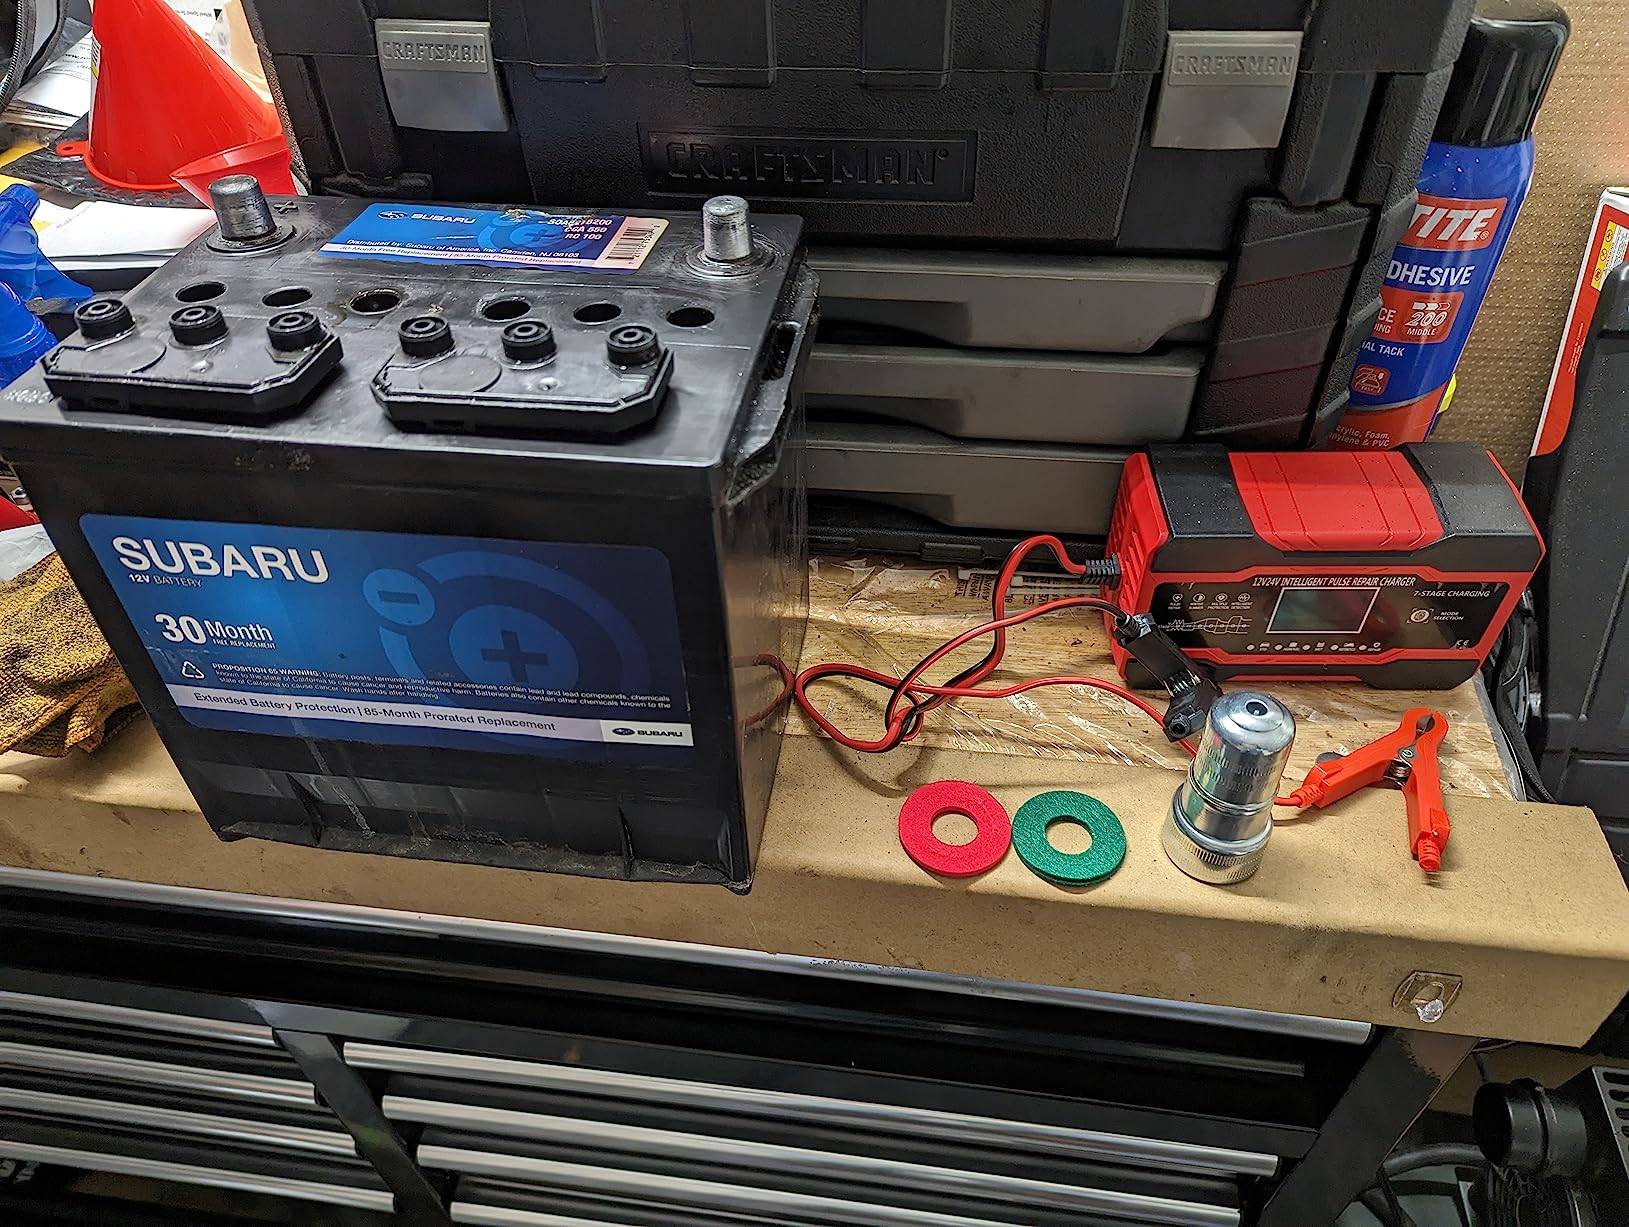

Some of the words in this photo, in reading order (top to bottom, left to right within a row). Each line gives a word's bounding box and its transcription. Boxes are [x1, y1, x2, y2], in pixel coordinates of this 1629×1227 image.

[382, 42, 486, 62] CRAFTSMAN
[1172, 55, 1293, 75] CRAFTSMAN
[667, 143, 934, 185] CRAFTSMAN
[411, 213, 476, 224] SUBARU
[397, 248, 447, 257] Replacement
[528, 256, 582, 264] Replacement
[447, 245, 481, 253] America,
[1386, 260, 1475, 286] DHESIVE
[1404, 311, 1448, 328] 200
[1374, 323, 1392, 334] ING
[1406, 328, 1437, 336] MIDDLE
[1378, 344, 1405, 357] TACK
[1371, 439, 1390, 447] PVC
[112, 536, 330, 584] SUBARU
[129, 573, 151, 584] 12V
[153, 576, 202, 588] BATTERY
[1252, 577, 1281, 587] 12V24V
[1280, 577, 1329, 587] INTELLIGENT
[1327, 577, 1353, 586] PULSE
[1351, 577, 1380, 586] REPAIR
[1379, 577, 1417, 587] CHARGER
[1413, 590, 1447, 598] 7-STAGE
[1447, 590, 1491, 598] CHARGING
[155, 614, 207, 645] 30
[204, 620, 273, 641] Month
[230, 640, 276, 650] REPLACEMENT
[211, 662, 268, 674] PROPOSITION
[279, 668, 321, 677] WARNING:
[322, 671, 349, 680] Battery
[453, 682, 498, 690] accessories
[499, 685, 527, 693] contain
[528, 687, 545, 695] lead
[562, 690, 580, 698] lead
[581, 692, 630, 700] compounds,
[630, 694, 671, 702] chemicals
[215, 670, 239, 678] known
[263, 674, 282, 682] state
[291, 675, 328, 684] California
[404, 684, 451, 694] reproductive
[452, 688, 474, 696] harm.
[475, 689, 510, 698] Batteries
[511, 692, 528, 700] also
[528, 694, 557, 703] contain
[557, 696, 578, 704] other
[579, 698, 619, 707] chemicals
[620, 700, 647, 708] known
[219, 677, 237, 685] state
[246, 679, 281, 688] California
[341, 686, 362, 694] Wash
[361, 688, 388, 696] hands
[193, 692, 248, 706] Extended
[250, 699, 293, 712] Battery
[295, 702, 357, 715] Protection
[364, 706, 422, 720] 85-Month
[423, 711, 475, 724] Prorated
[477, 715, 557, 731] Replacement
[637, 729, 683, 738] SUBARU
